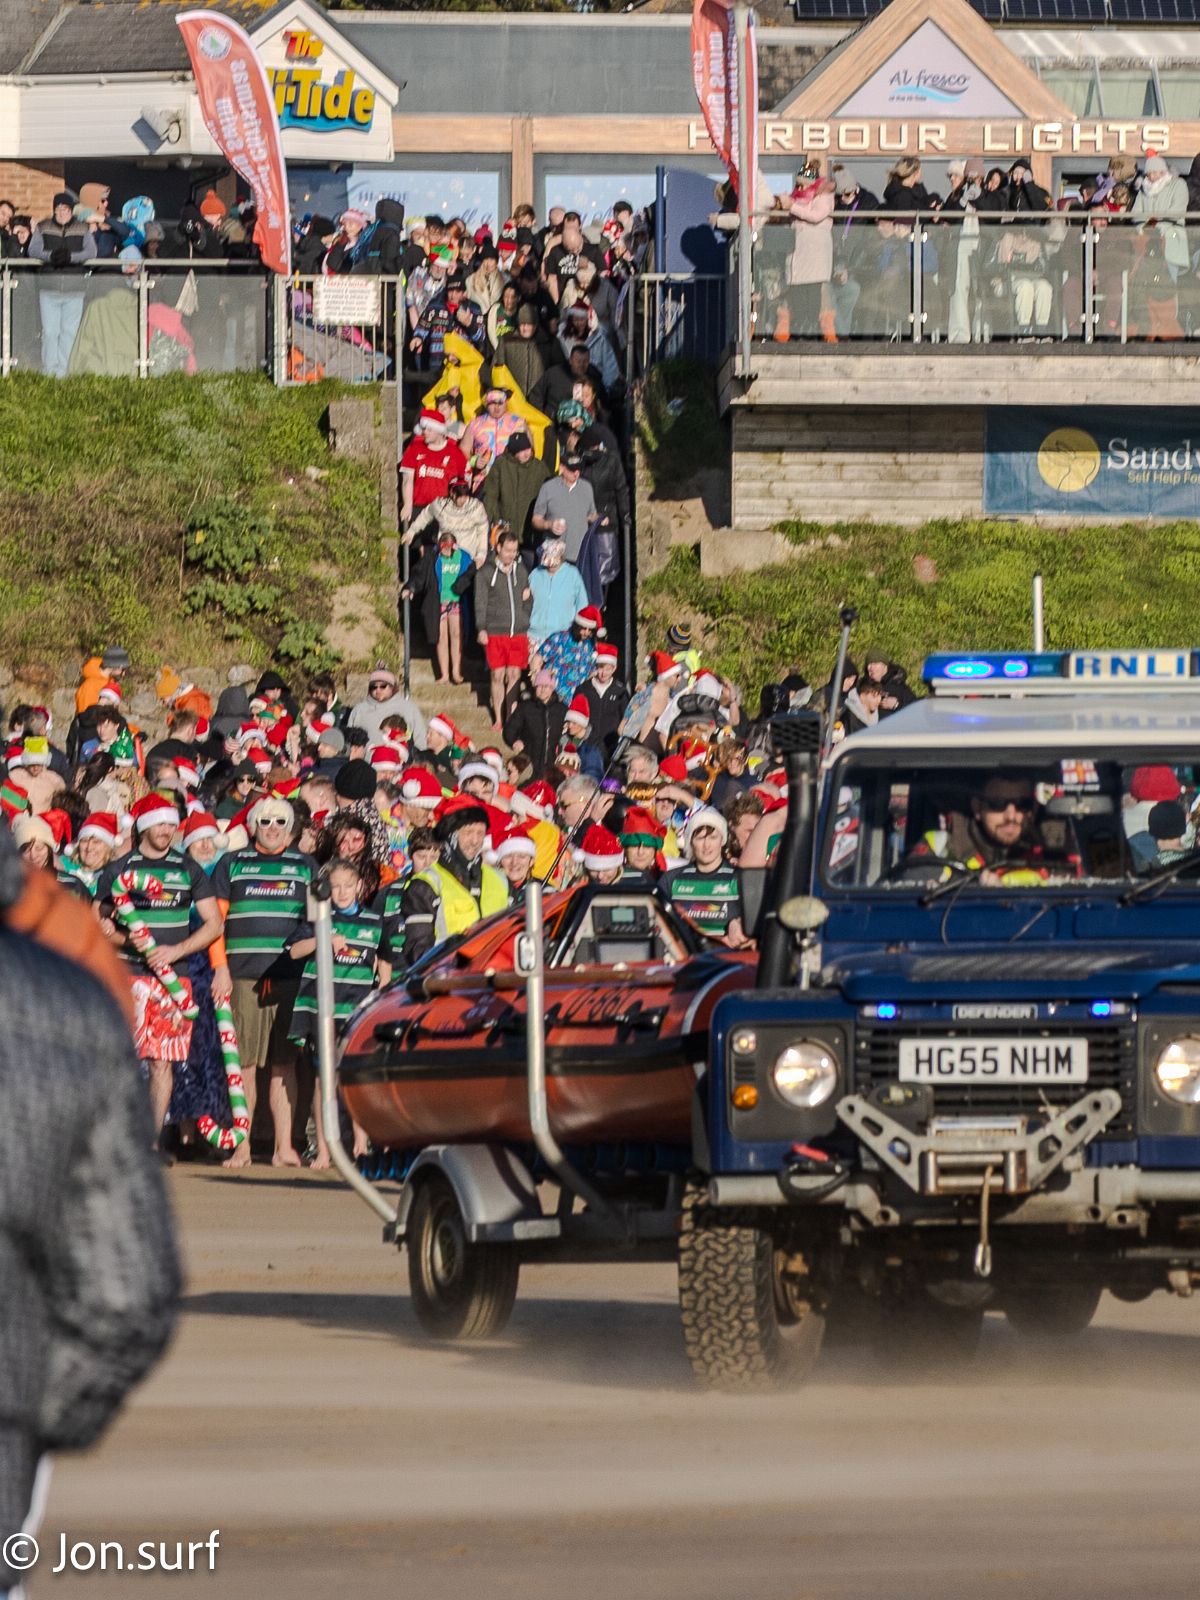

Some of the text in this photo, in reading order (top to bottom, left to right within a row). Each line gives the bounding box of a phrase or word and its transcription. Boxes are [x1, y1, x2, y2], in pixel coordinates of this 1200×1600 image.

[283, 31, 324, 59] The
[915, 69, 970, 90] fresco
[688, 121, 1170, 152] HRBOUR LIGHTS
[1127, 471, 1150, 483] Self
[1153, 472, 1181, 486] Help
[1074, 656, 1186, 677] RNLI
[957, 1006, 1032, 1019] DEFENDER
[914, 1046, 1073, 1076] HG55 NHM
